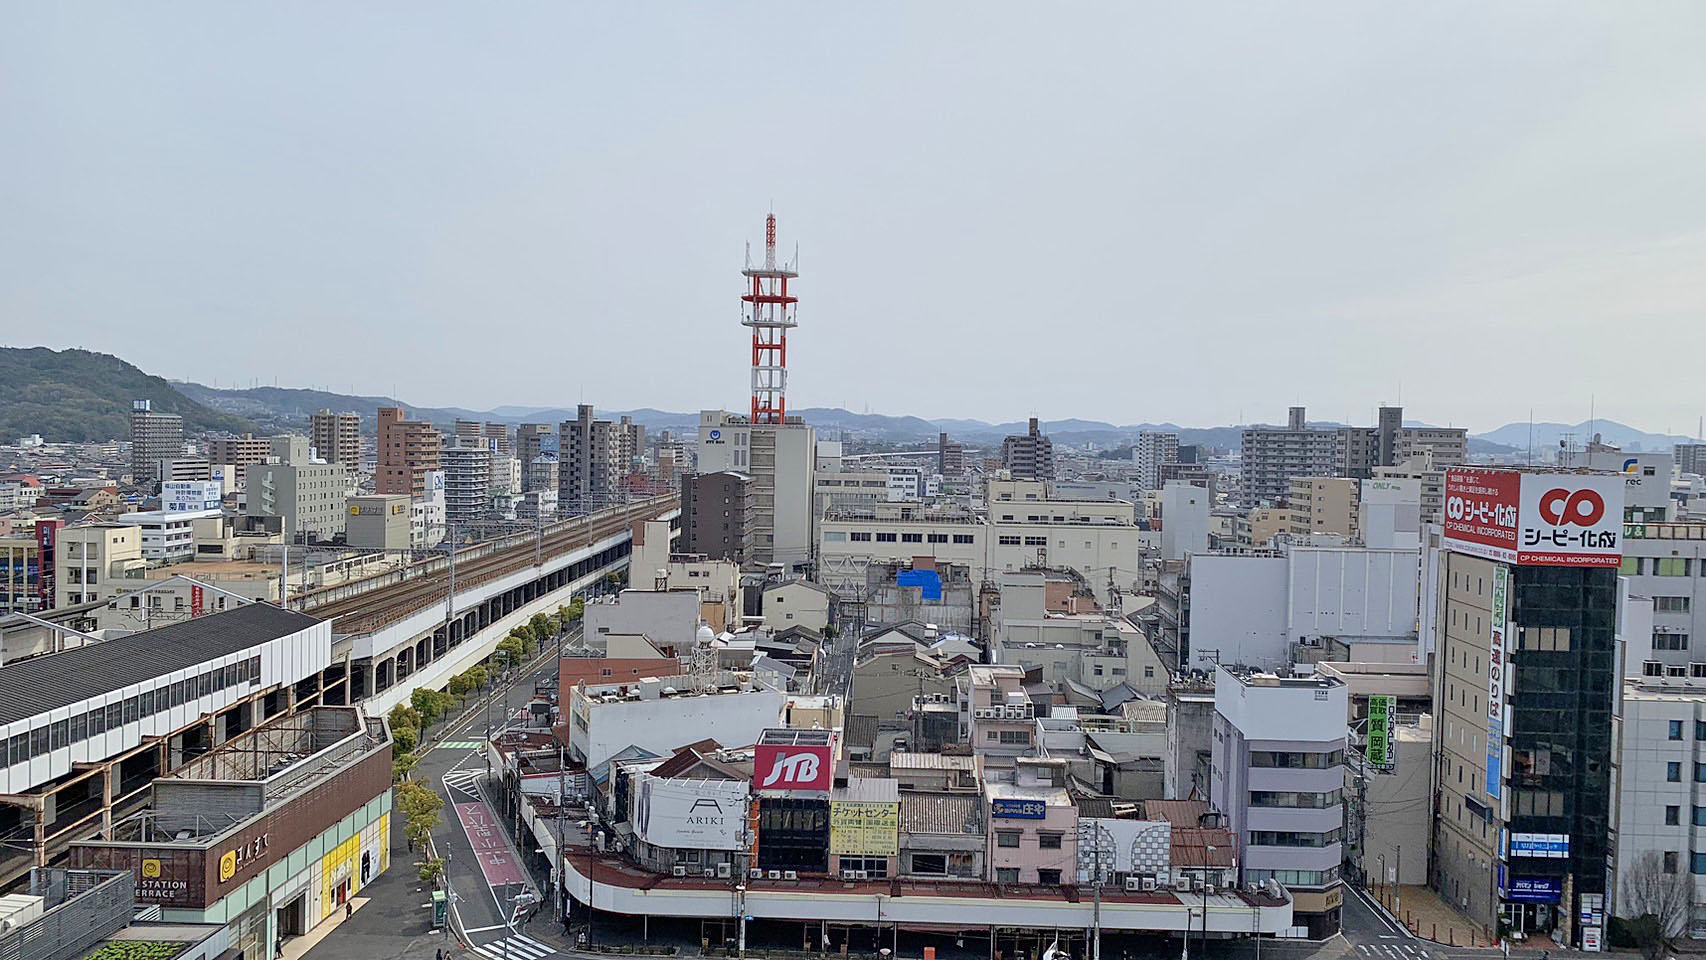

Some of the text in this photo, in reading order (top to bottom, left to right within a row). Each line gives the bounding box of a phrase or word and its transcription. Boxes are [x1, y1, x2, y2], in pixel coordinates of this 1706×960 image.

[1465, 499, 1517, 528] シーピー化成
[1453, 523, 1476, 534] CHEMICAL
[1477, 526, 1516, 541] INCORPORATED
[1525, 528, 1616, 548] シーピー化成
[762, 752, 820, 787] JTB
[833, 807, 897, 818] チケットセンター
[686, 816, 724, 825] ARIKI
[142, 880, 187, 889] STATION
[135, 889, 175, 898] ERRACE
